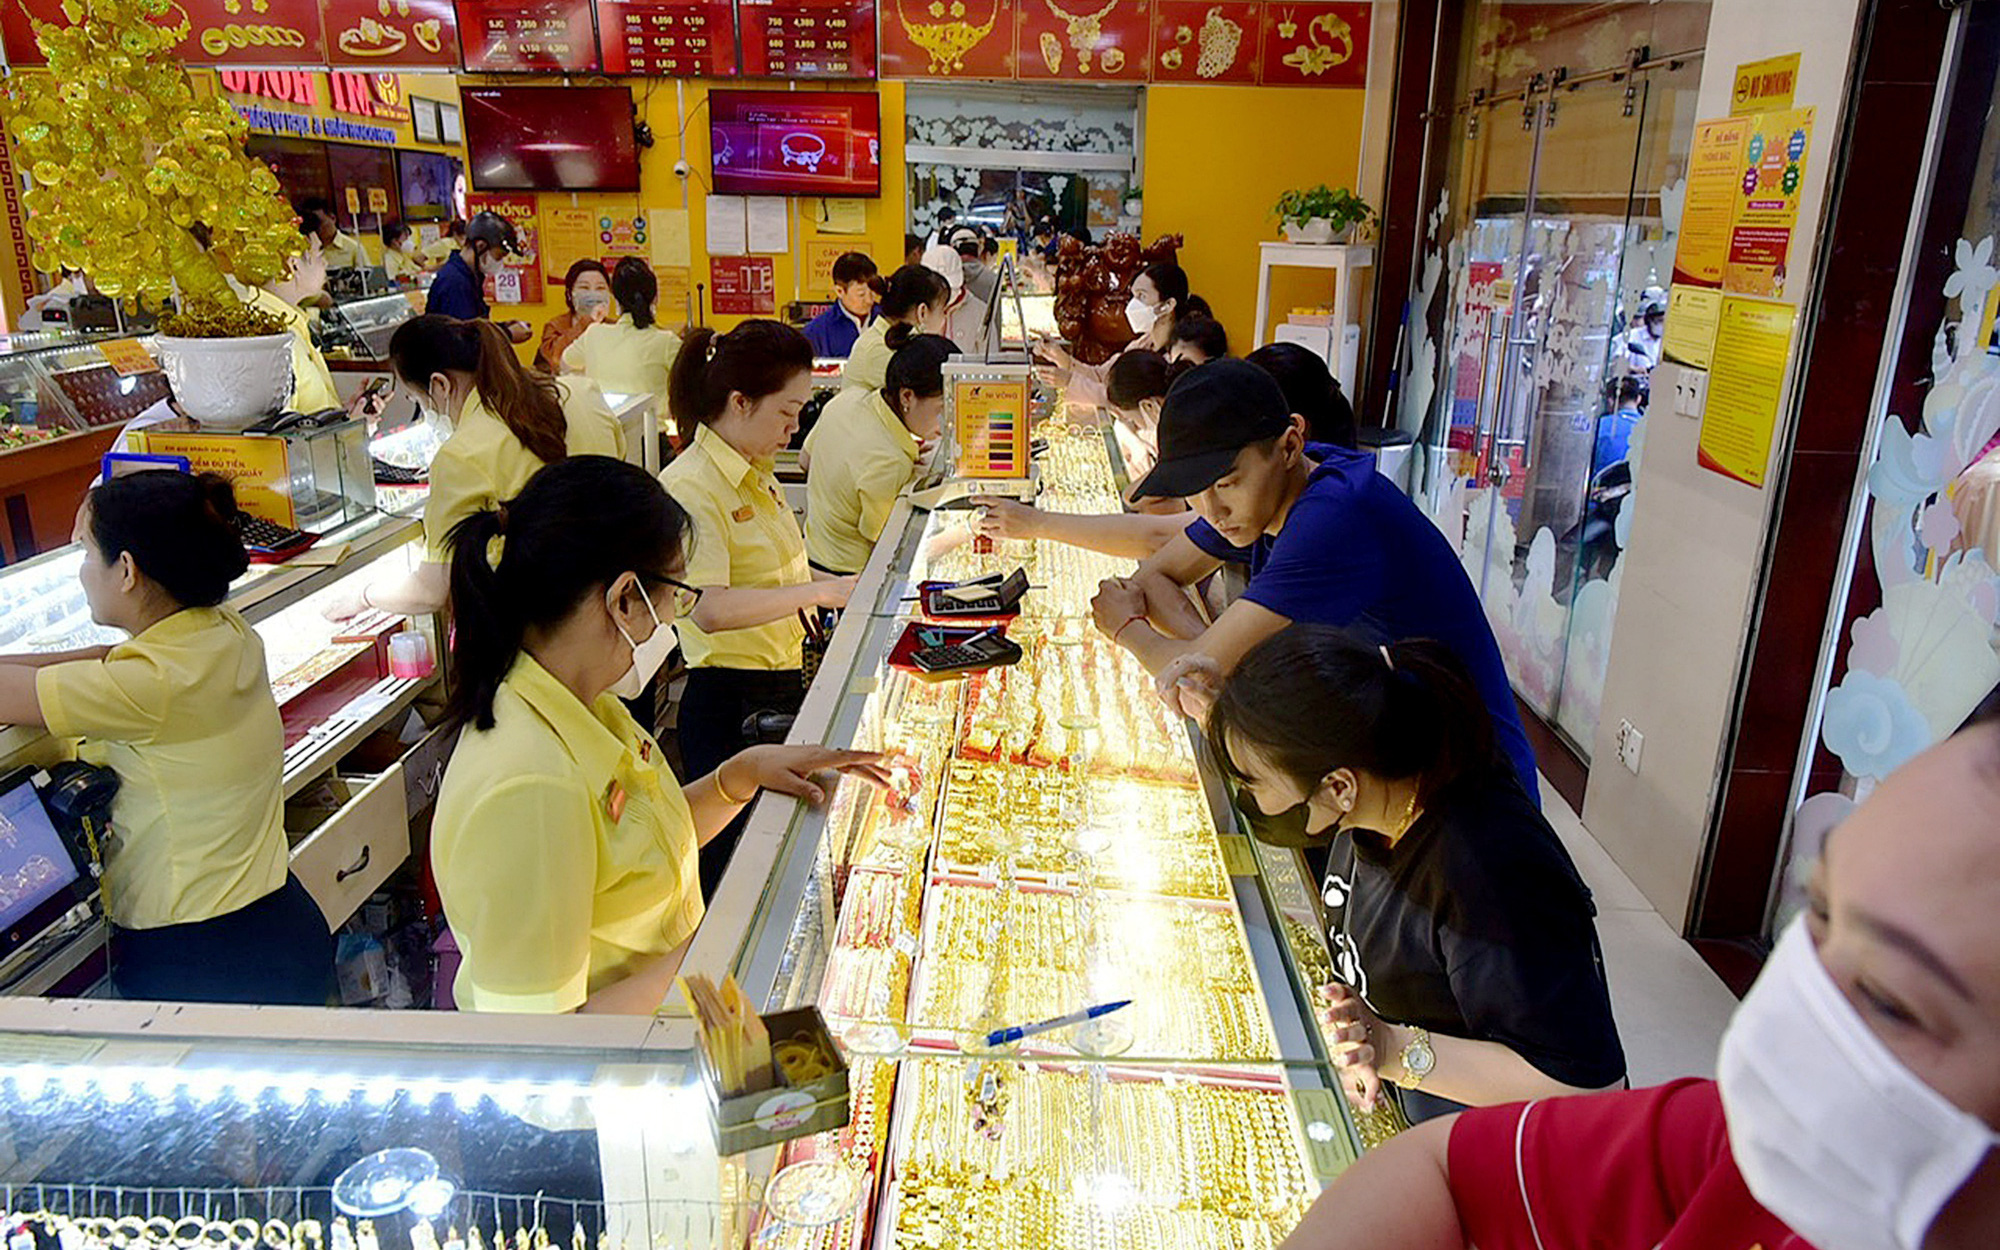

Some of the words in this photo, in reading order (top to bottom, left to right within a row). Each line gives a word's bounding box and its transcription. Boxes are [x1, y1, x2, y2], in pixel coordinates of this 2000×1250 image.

[488, 20, 504, 29] SJC
[769, 61, 785, 70] 610
[1750, 74, 1761, 99] NO
[1760, 70, 1793, 97] SMOKING
[498, 274, 516, 287] 28
